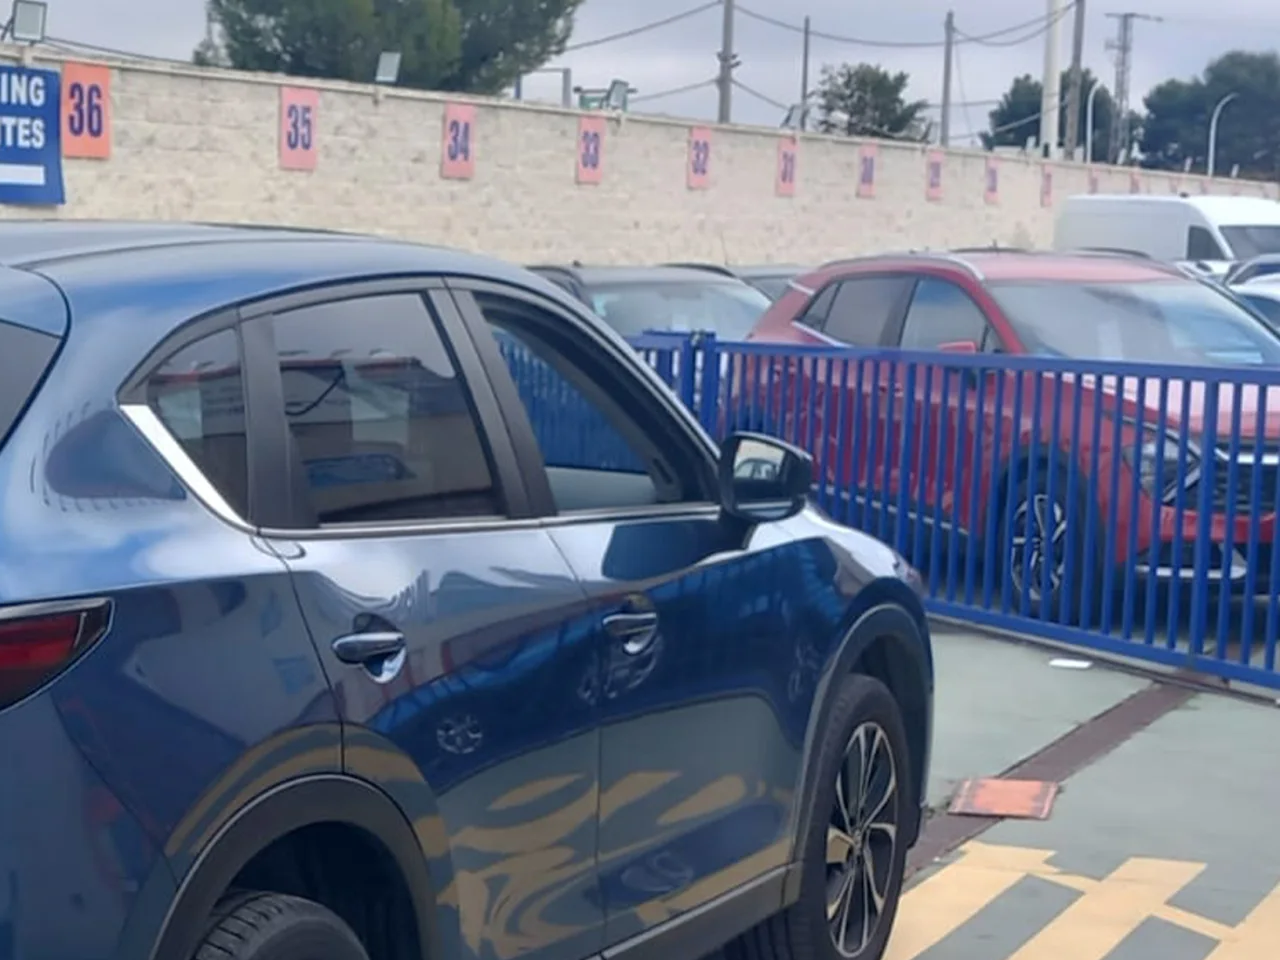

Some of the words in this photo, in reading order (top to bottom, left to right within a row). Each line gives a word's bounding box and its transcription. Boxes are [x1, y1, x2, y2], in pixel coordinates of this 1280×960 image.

[68, 82, 103, 138] 36
[286, 104, 313, 151] 35
[447, 119, 471, 162] 34
[581, 131, 601, 170] 33
[692, 140, 710, 176] 32
